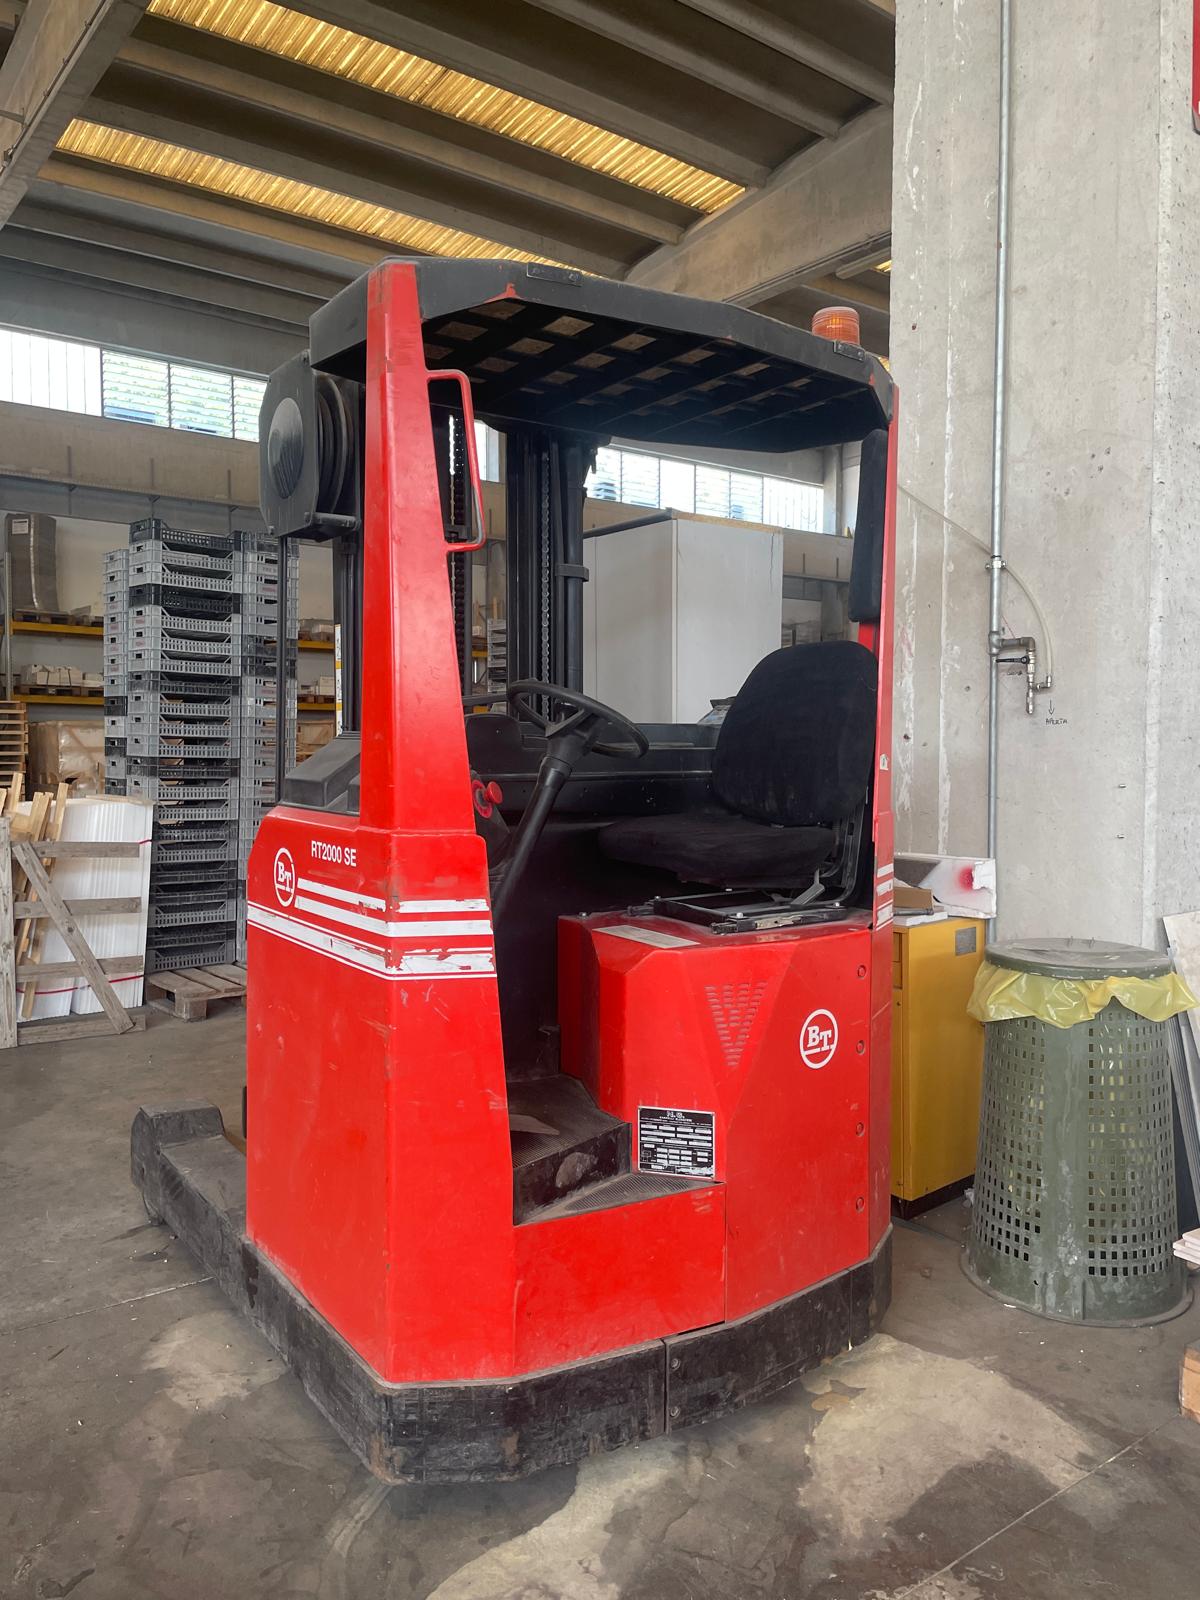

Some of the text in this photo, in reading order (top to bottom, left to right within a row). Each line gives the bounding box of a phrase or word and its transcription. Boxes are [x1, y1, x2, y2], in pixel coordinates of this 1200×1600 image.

[311, 840, 357, 867] RT2000 SE
[277, 861, 292, 893] BT
[807, 1025, 832, 1051] BT
